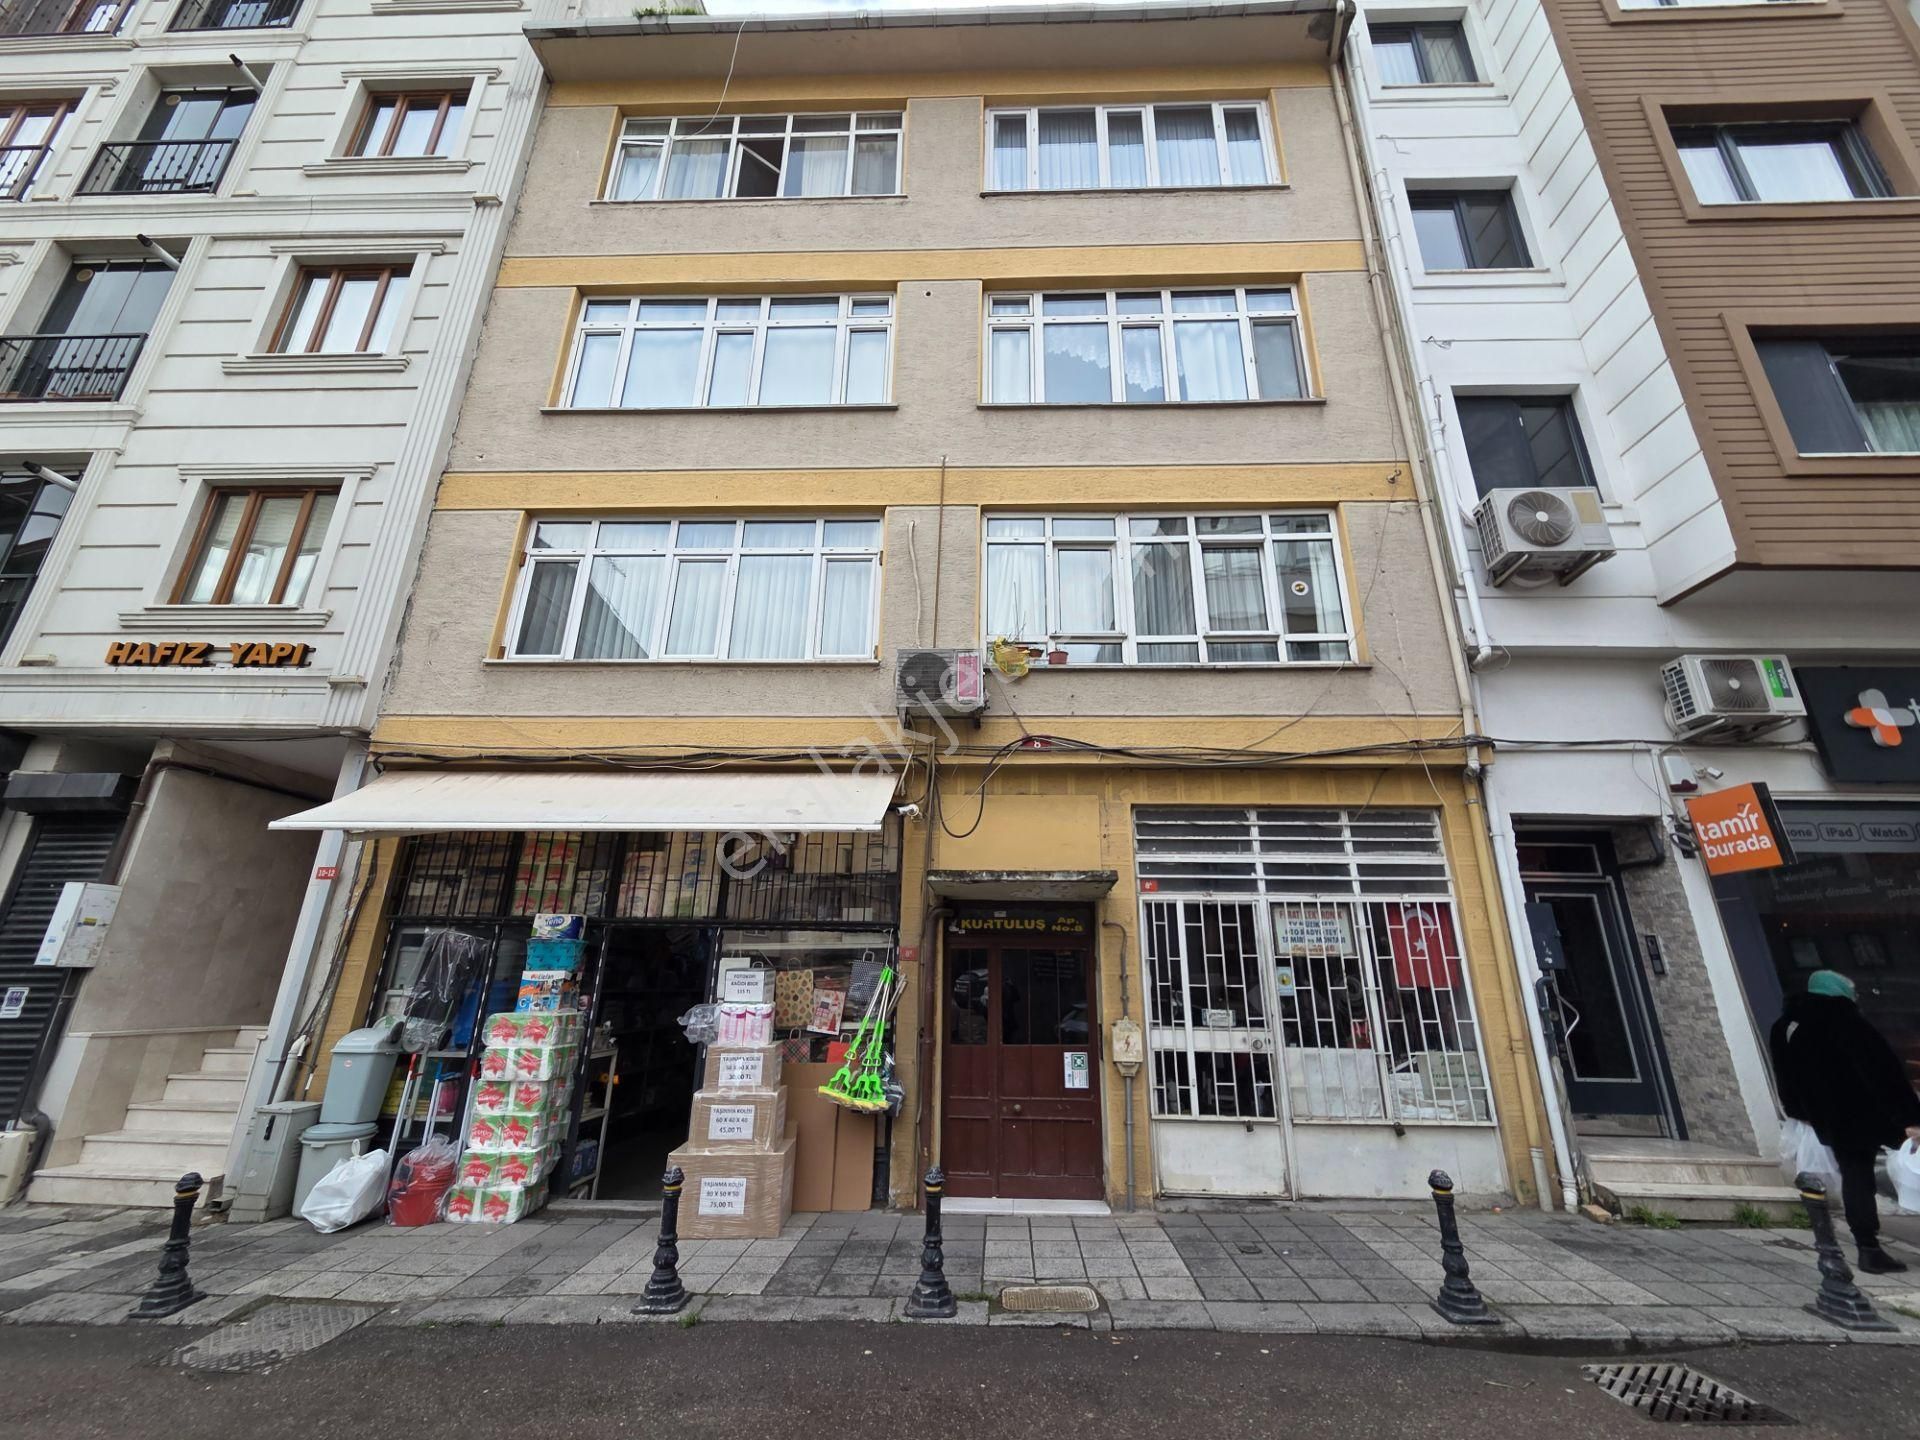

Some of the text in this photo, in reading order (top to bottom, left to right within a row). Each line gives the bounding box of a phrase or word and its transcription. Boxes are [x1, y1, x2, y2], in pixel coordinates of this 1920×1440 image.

[105, 642, 309, 666] HAFIZ YAPI
[1696, 803, 1760, 842] tamir
[1825, 827, 1854, 838] iPad
[1869, 826, 1908, 838] Watch
[1703, 834, 1772, 859] burada
[318, 869, 336, 877] 10-12
[961, 918, 1046, 931] KURTULUŞ
[1057, 916, 1080, 924] Ap.
